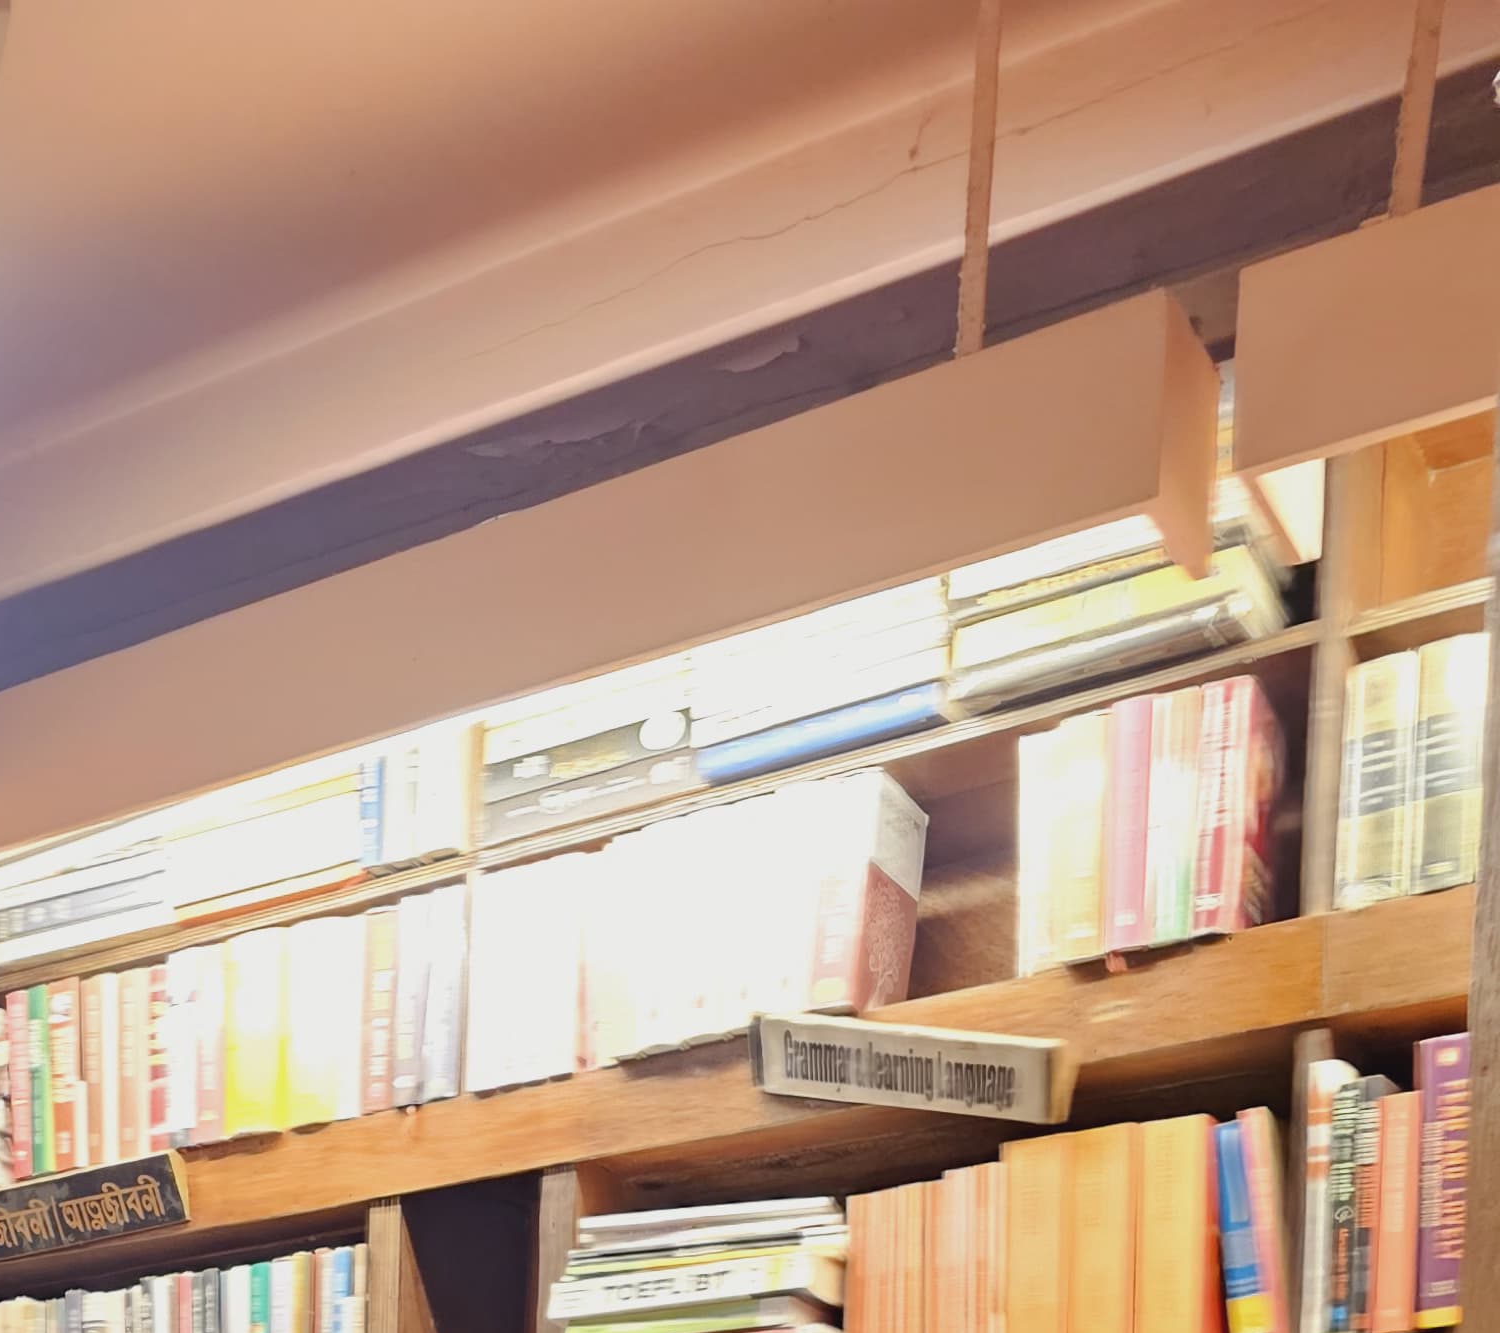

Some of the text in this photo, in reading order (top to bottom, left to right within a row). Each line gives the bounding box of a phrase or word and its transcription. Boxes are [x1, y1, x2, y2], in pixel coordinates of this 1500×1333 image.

[784, 1029, 850, 1083] Grammar
[868, 1041, 934, 1100] learning
[937, 1051, 1016, 1110] Language
[59, 1175, 165, 1232] আত্মজীবনী
